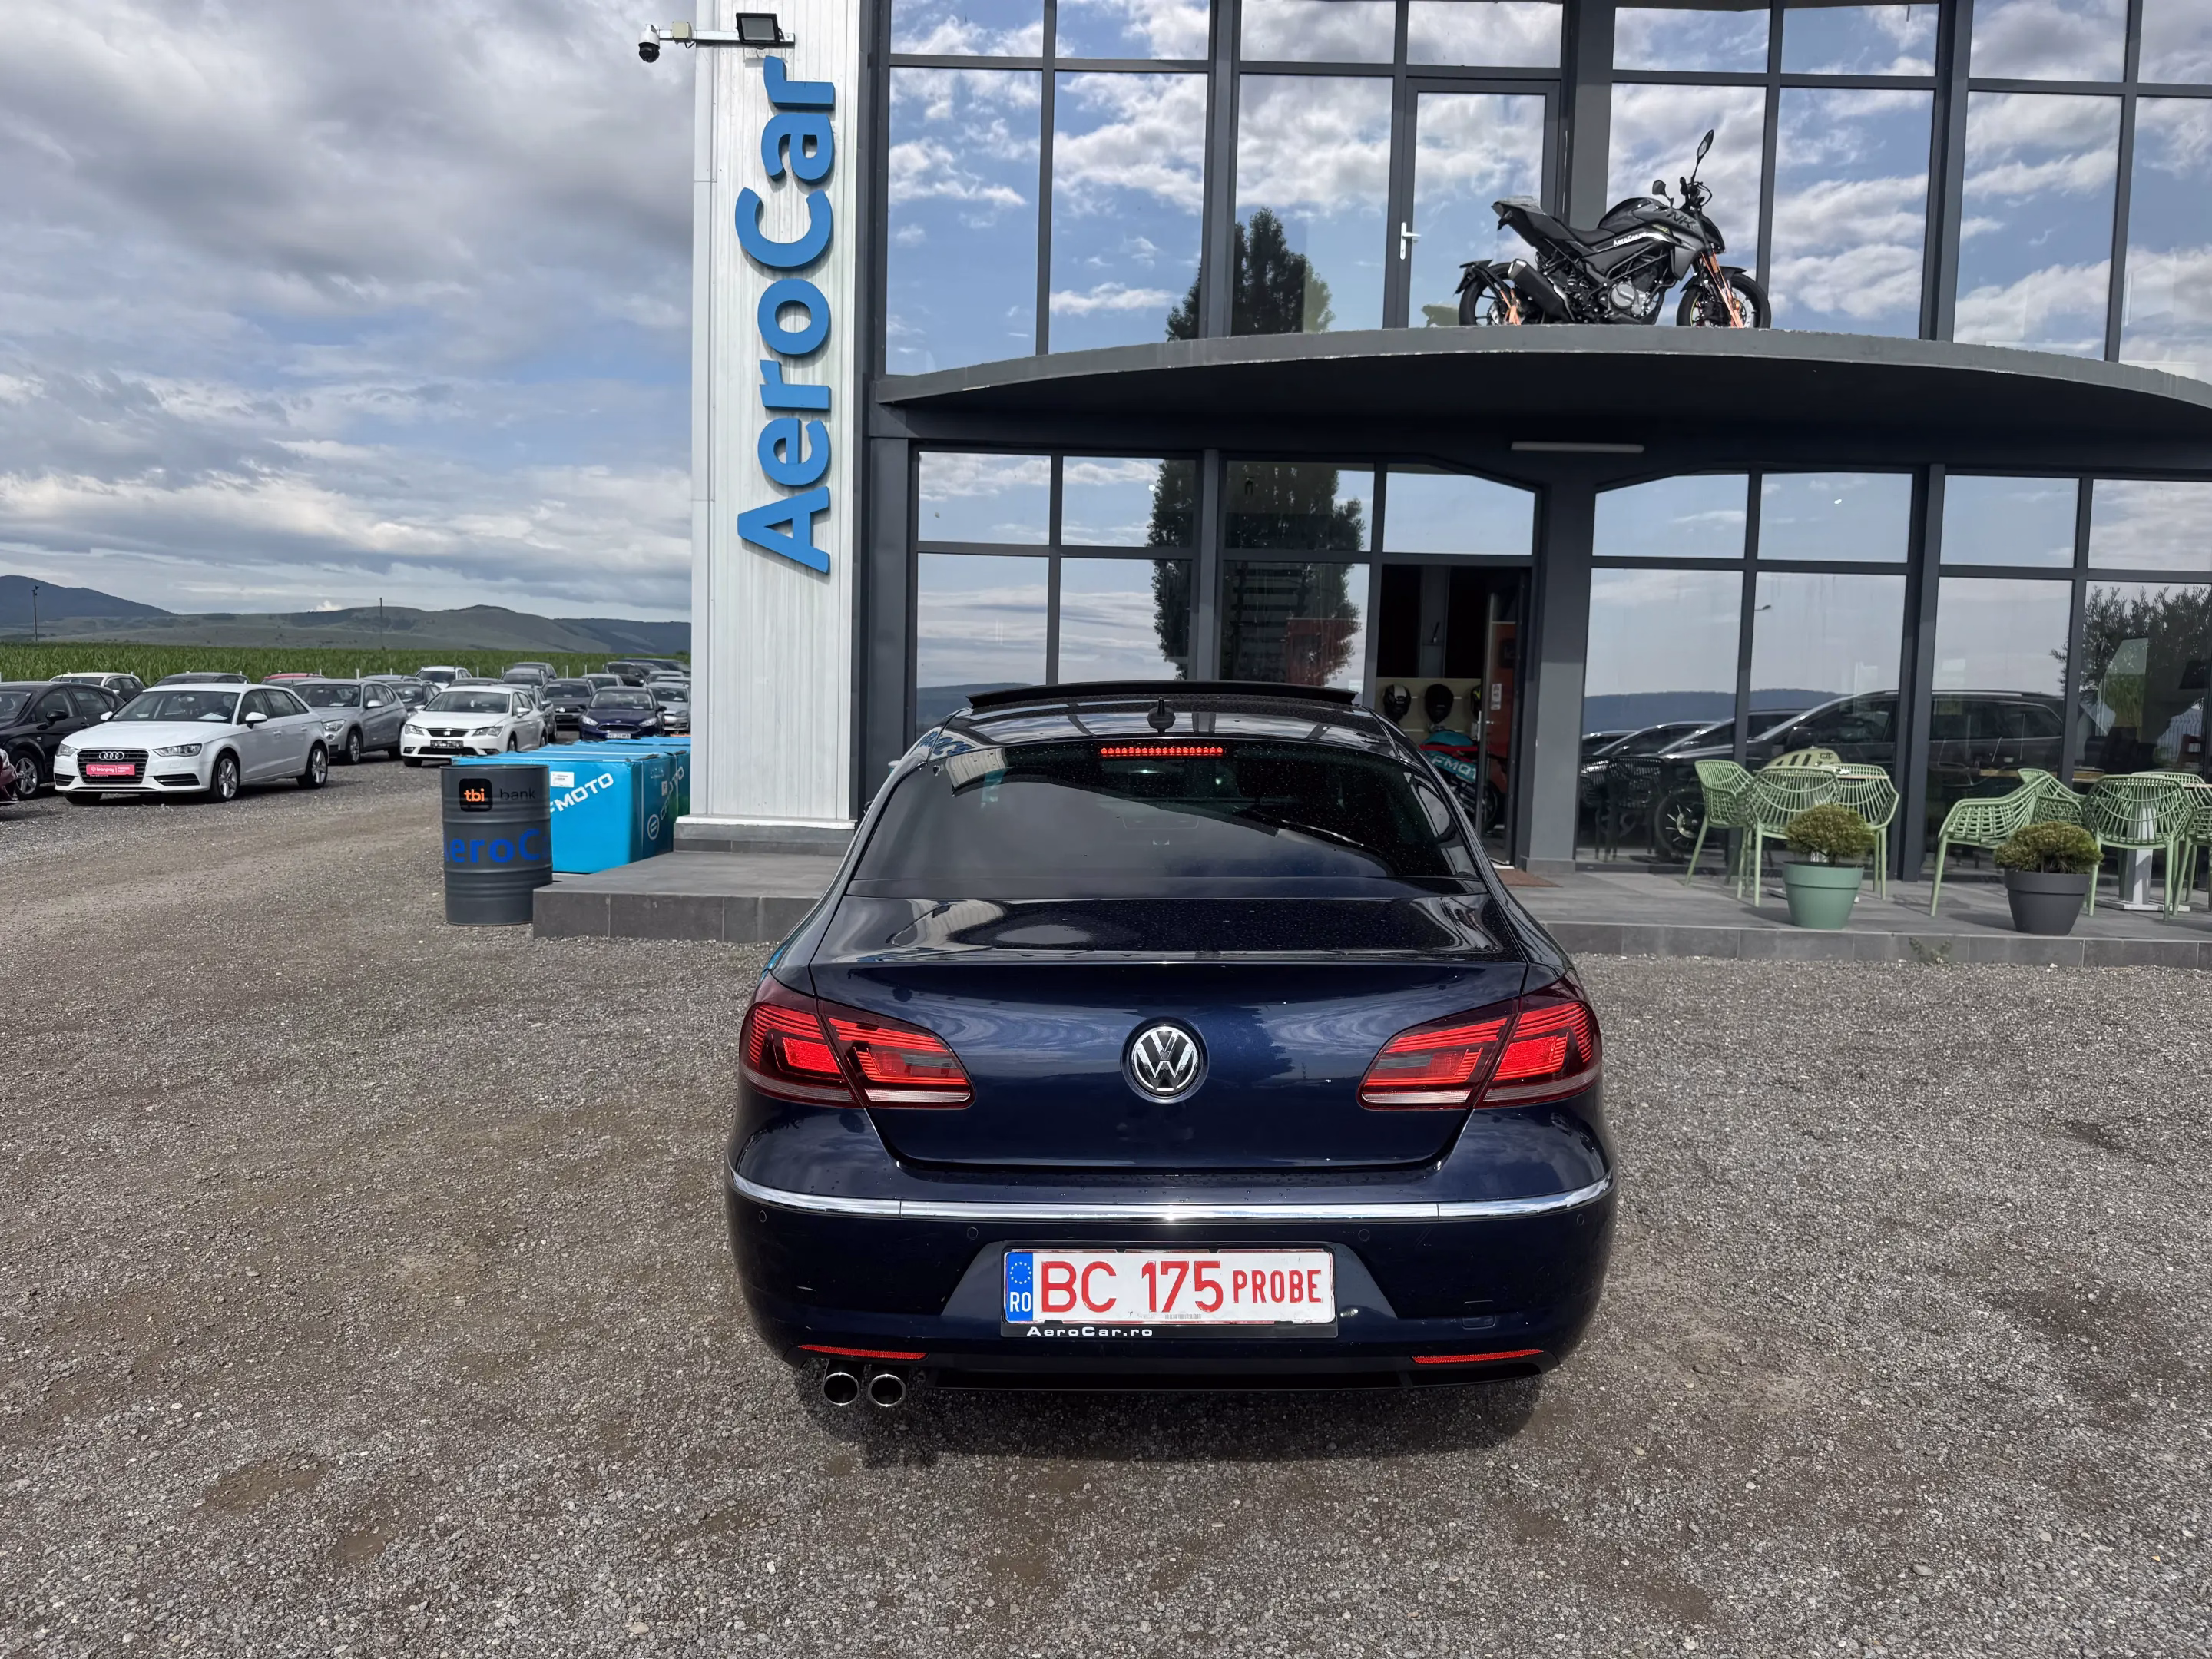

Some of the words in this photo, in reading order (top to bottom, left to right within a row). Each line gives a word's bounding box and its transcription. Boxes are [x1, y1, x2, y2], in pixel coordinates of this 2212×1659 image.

[734, 55, 836, 575] AeroCar
[464, 788, 485, 802] tbi
[500, 787, 535, 800] bank
[1010, 1291, 1031, 1313] RO
[1041, 1260, 1117, 1313] BC
[1141, 1260, 1224, 1313] 175
[1233, 1270, 1323, 1303] PROBE
[1026, 1326, 1153, 1337] AeroCar.ro
